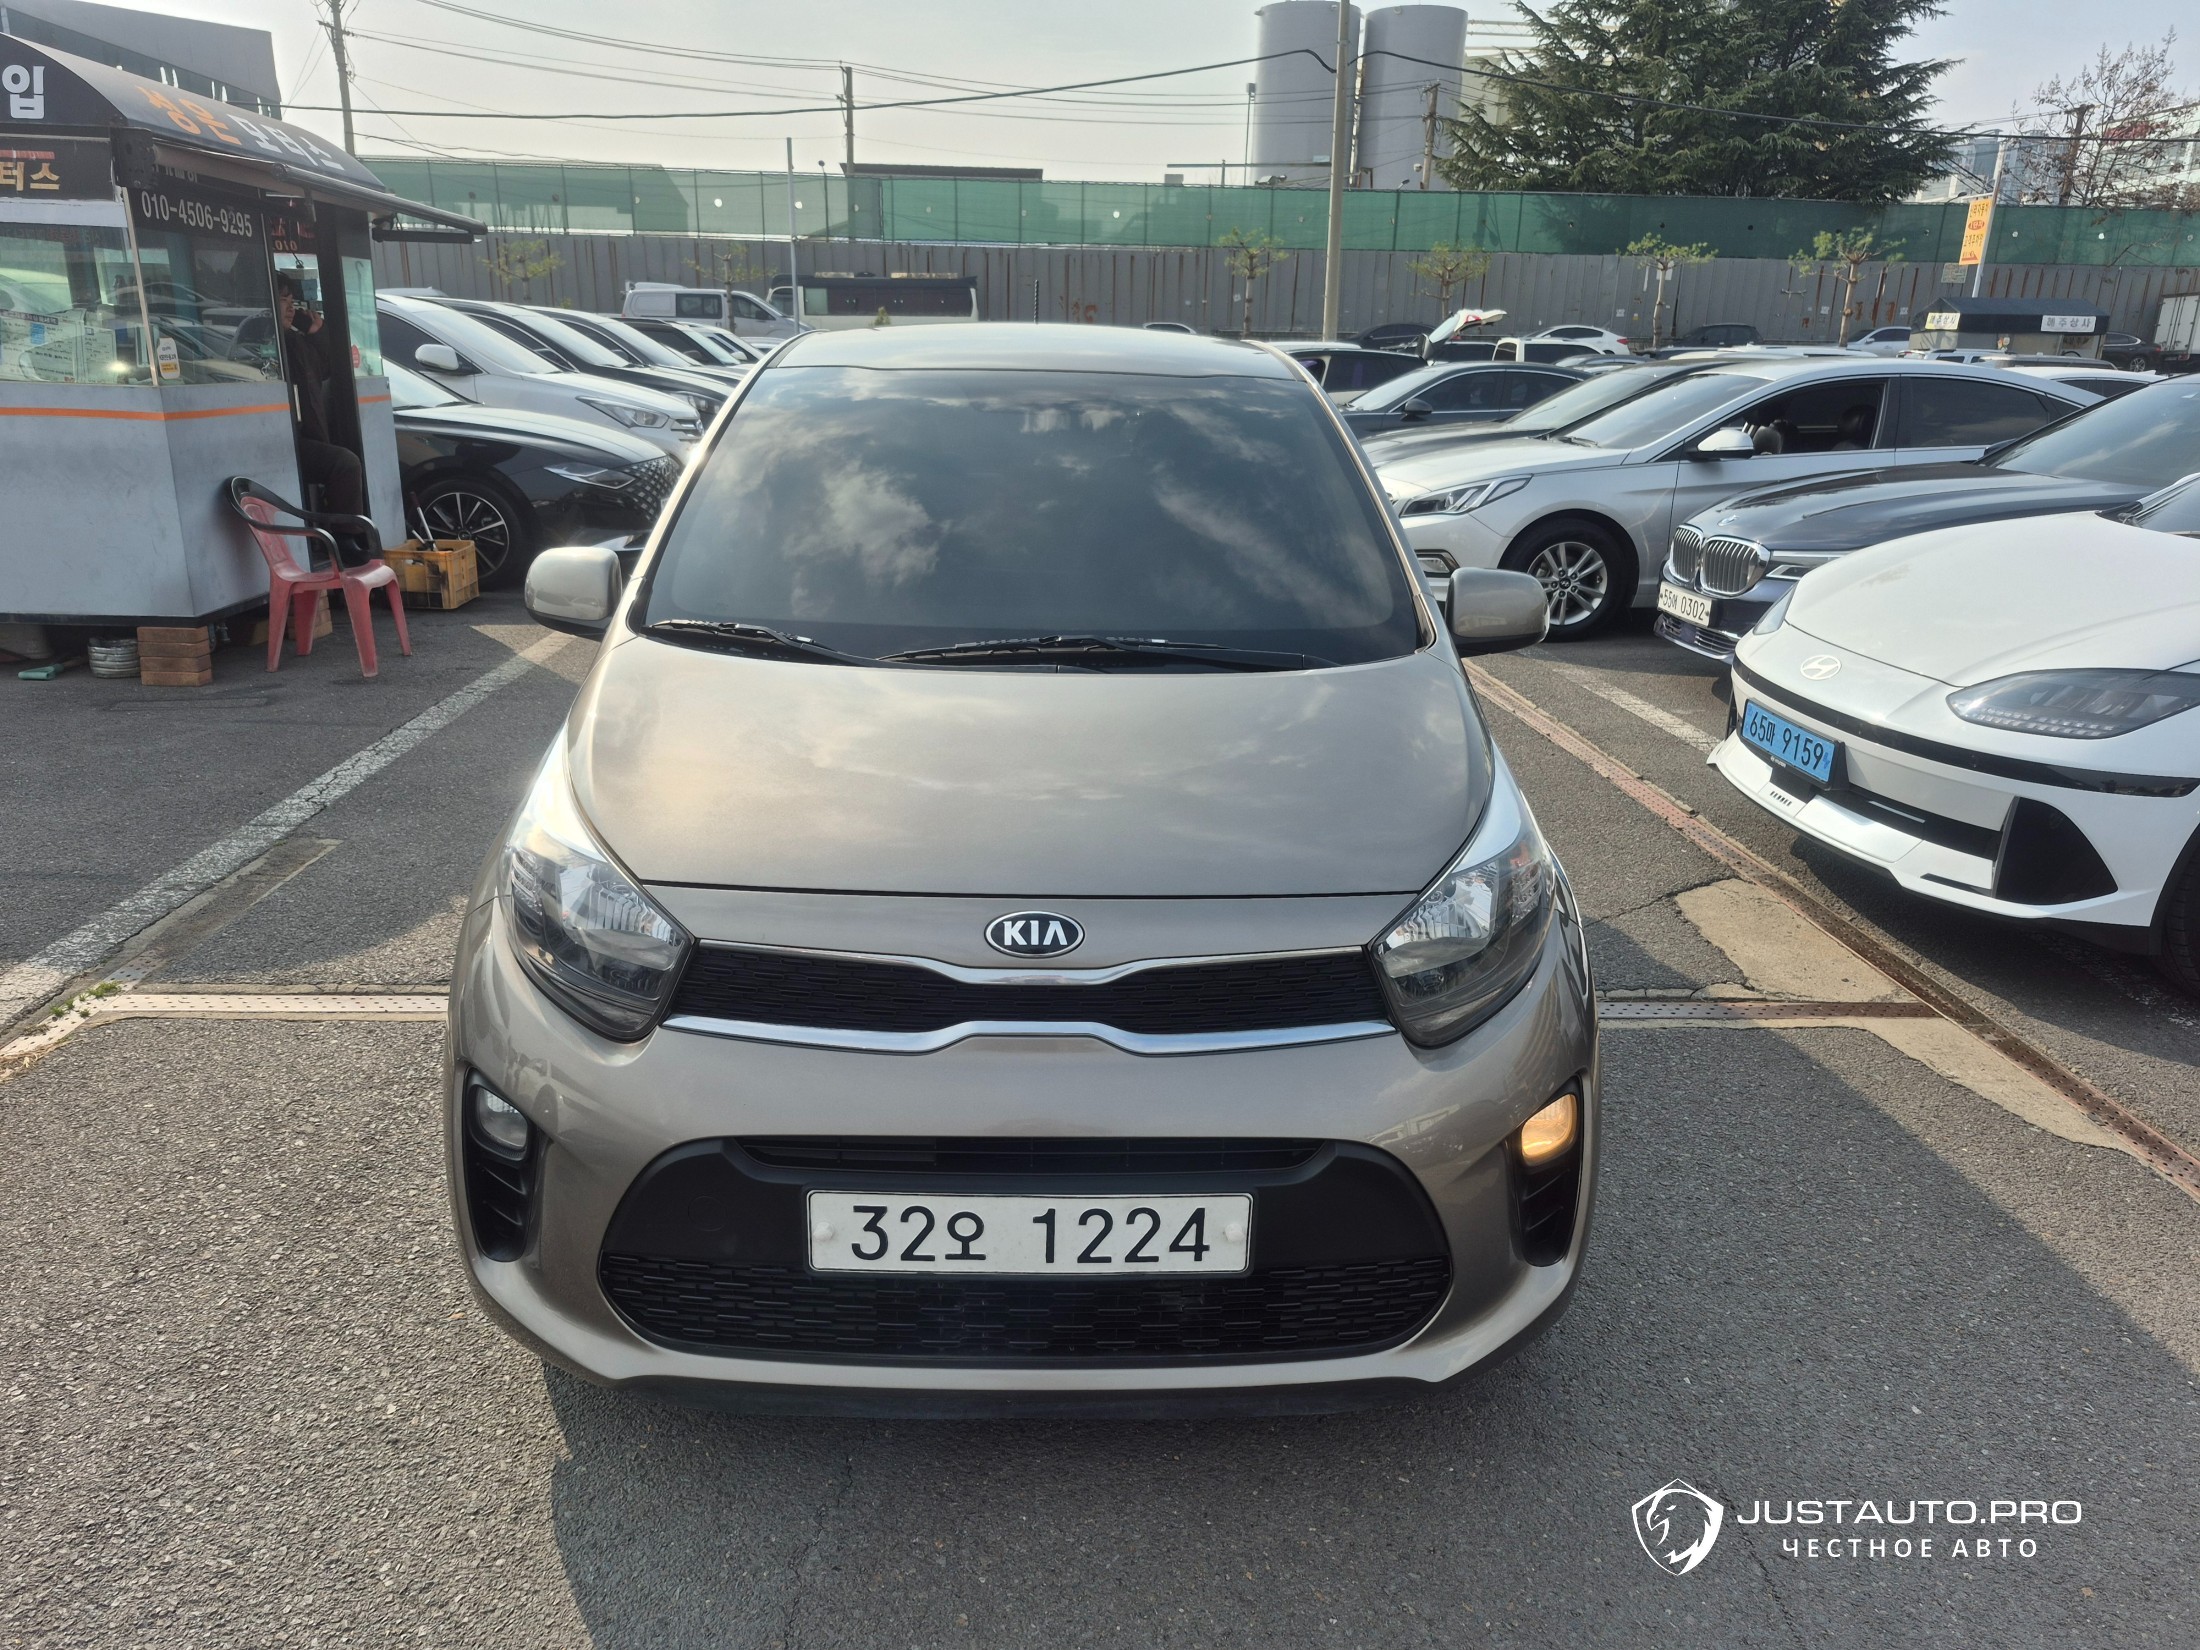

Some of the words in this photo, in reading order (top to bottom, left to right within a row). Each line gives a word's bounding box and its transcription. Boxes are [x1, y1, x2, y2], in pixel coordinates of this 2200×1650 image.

[226, 113, 345, 171] 모터스
[141, 190, 253, 238] 010-4506-9295
[1680, 595, 1706, 621] 0302
[1749, 711, 1776, 747] 65마
[1782, 727, 1824, 771] 9159
[1003, 920, 1068, 946] KIA
[851, 1205, 987, 1261] 32오
[1032, 1207, 1210, 1264] 1224
